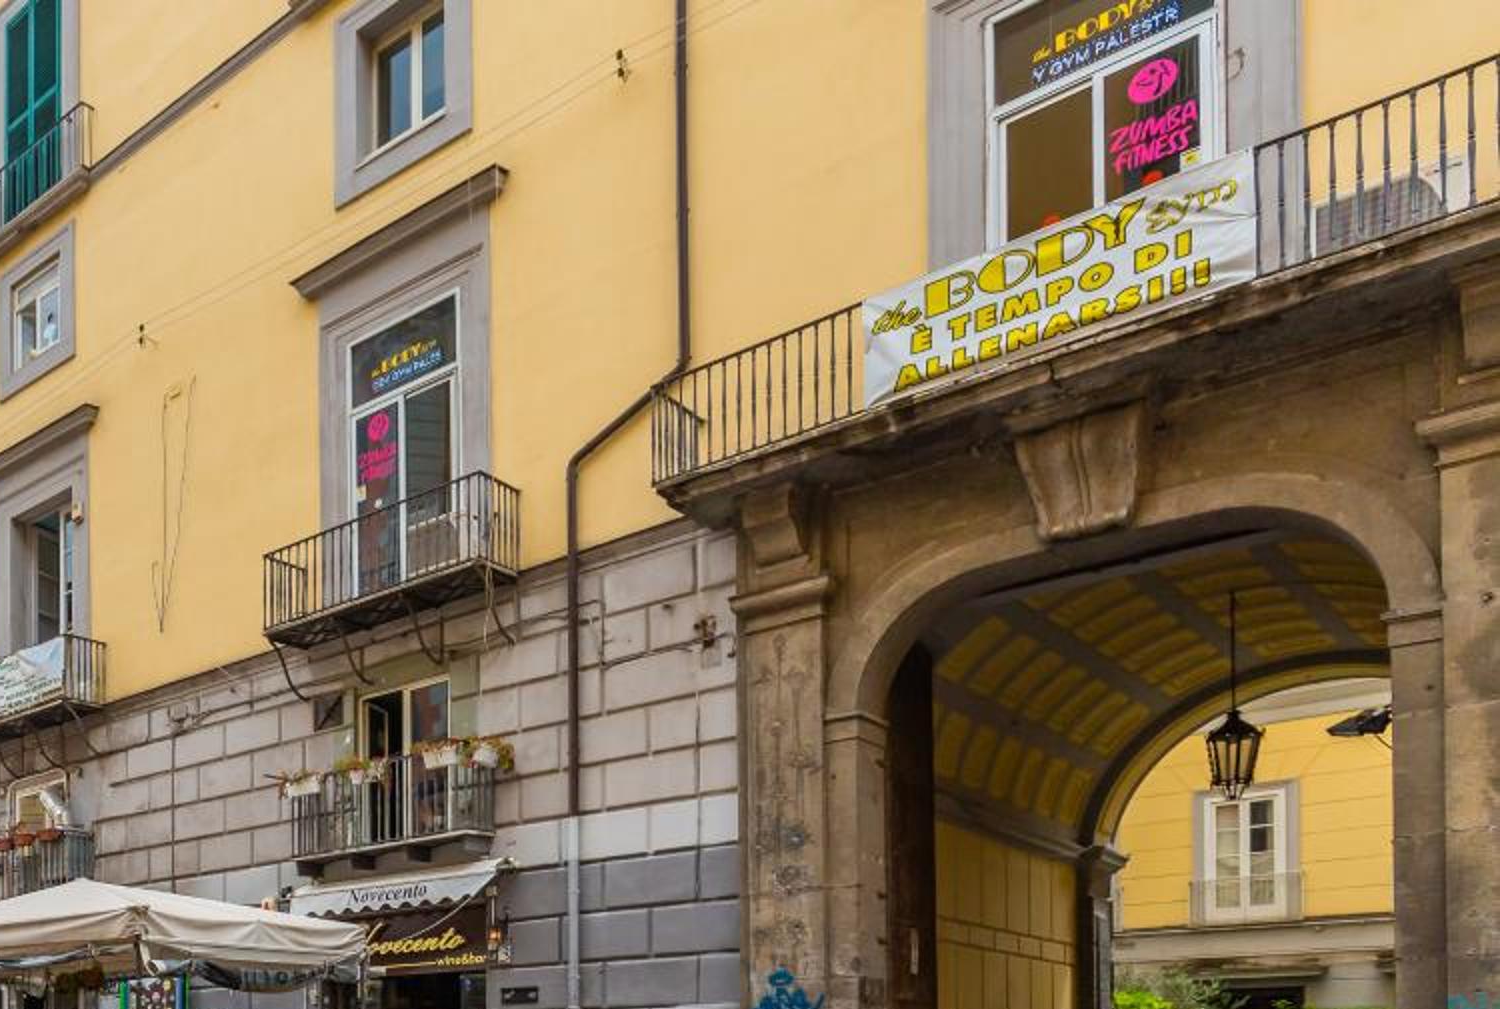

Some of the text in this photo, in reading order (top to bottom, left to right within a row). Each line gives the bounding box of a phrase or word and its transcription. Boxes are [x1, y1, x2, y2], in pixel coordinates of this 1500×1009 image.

[1055, 0, 1139, 52] BODY
[1050, 49, 1090, 76] GYM
[1109, 100, 1198, 153] ZUMBA
[1114, 125, 1193, 175] FITNESS
[872, 178, 1237, 335] the BODY gym
[910, 229, 1192, 354] È TEMPO DI
[894, 257, 1211, 392] ALLENARSI!!
[347, 884, 427, 905] Novecento
